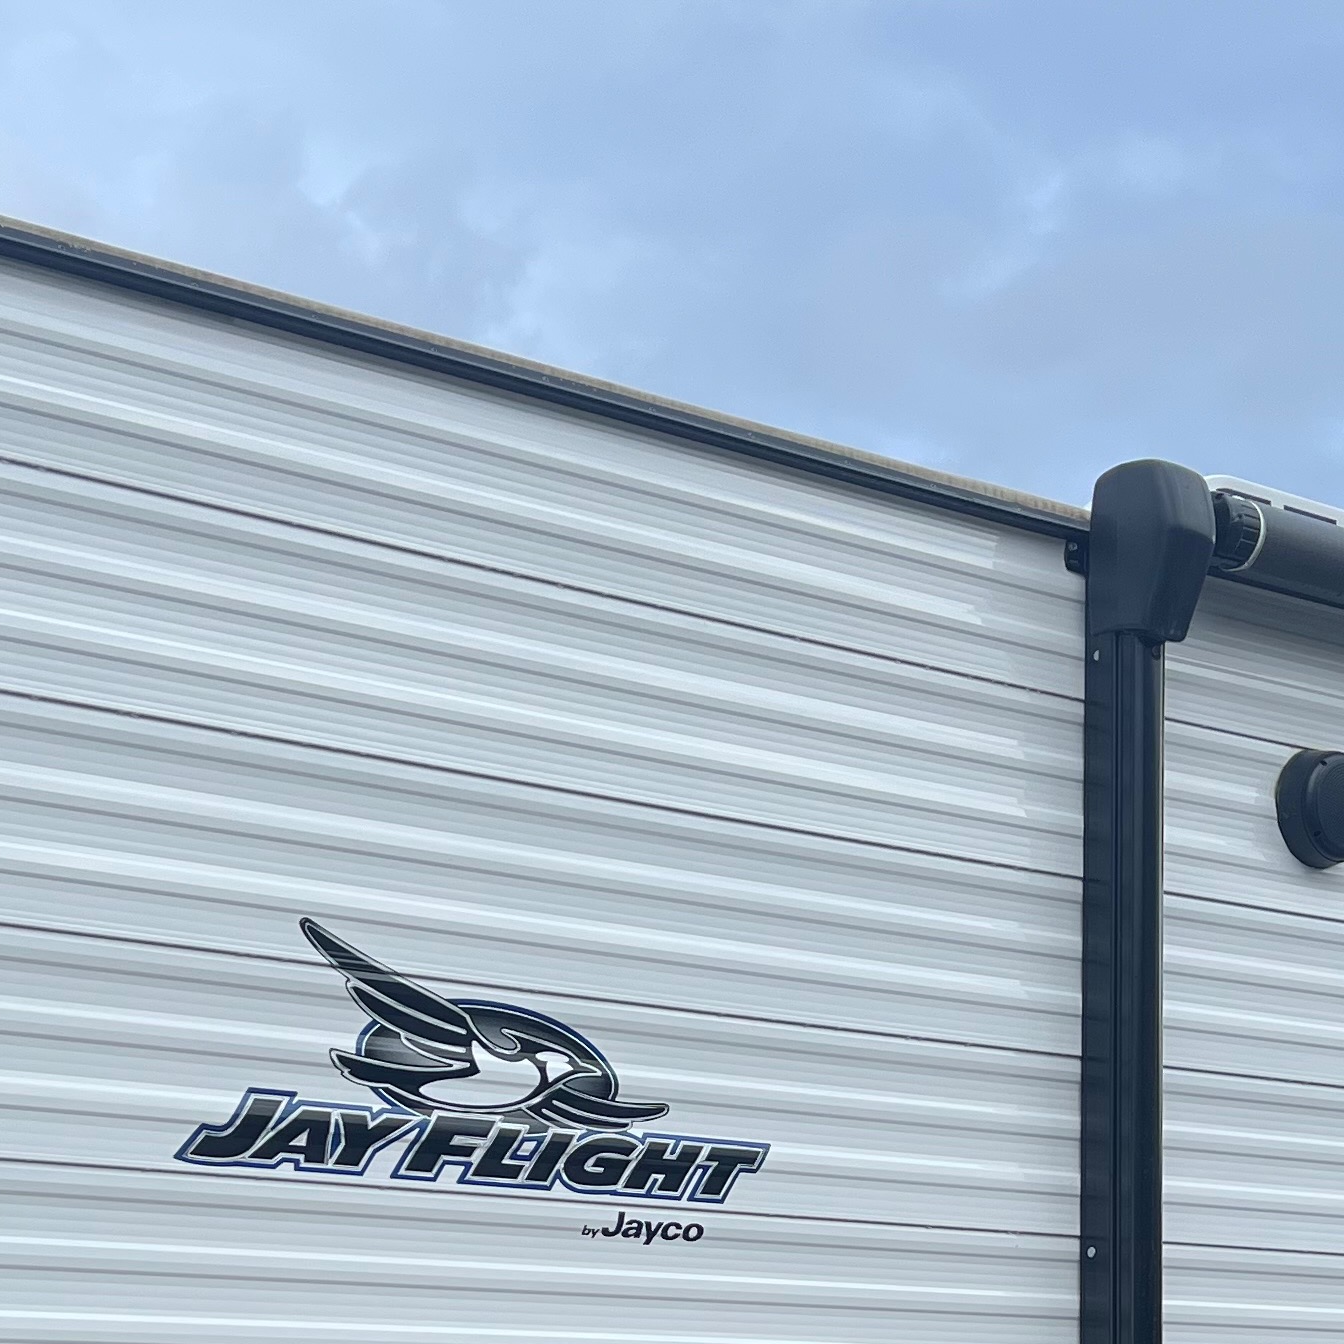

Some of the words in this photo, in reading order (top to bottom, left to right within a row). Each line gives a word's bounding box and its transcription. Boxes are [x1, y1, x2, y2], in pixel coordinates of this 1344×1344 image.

[173, 1086, 424, 1177] JAY
[390, 1108, 771, 1204] FLIGHT
[581, 1224, 600, 1239] by
[601, 1211, 705, 1246] Jayco
